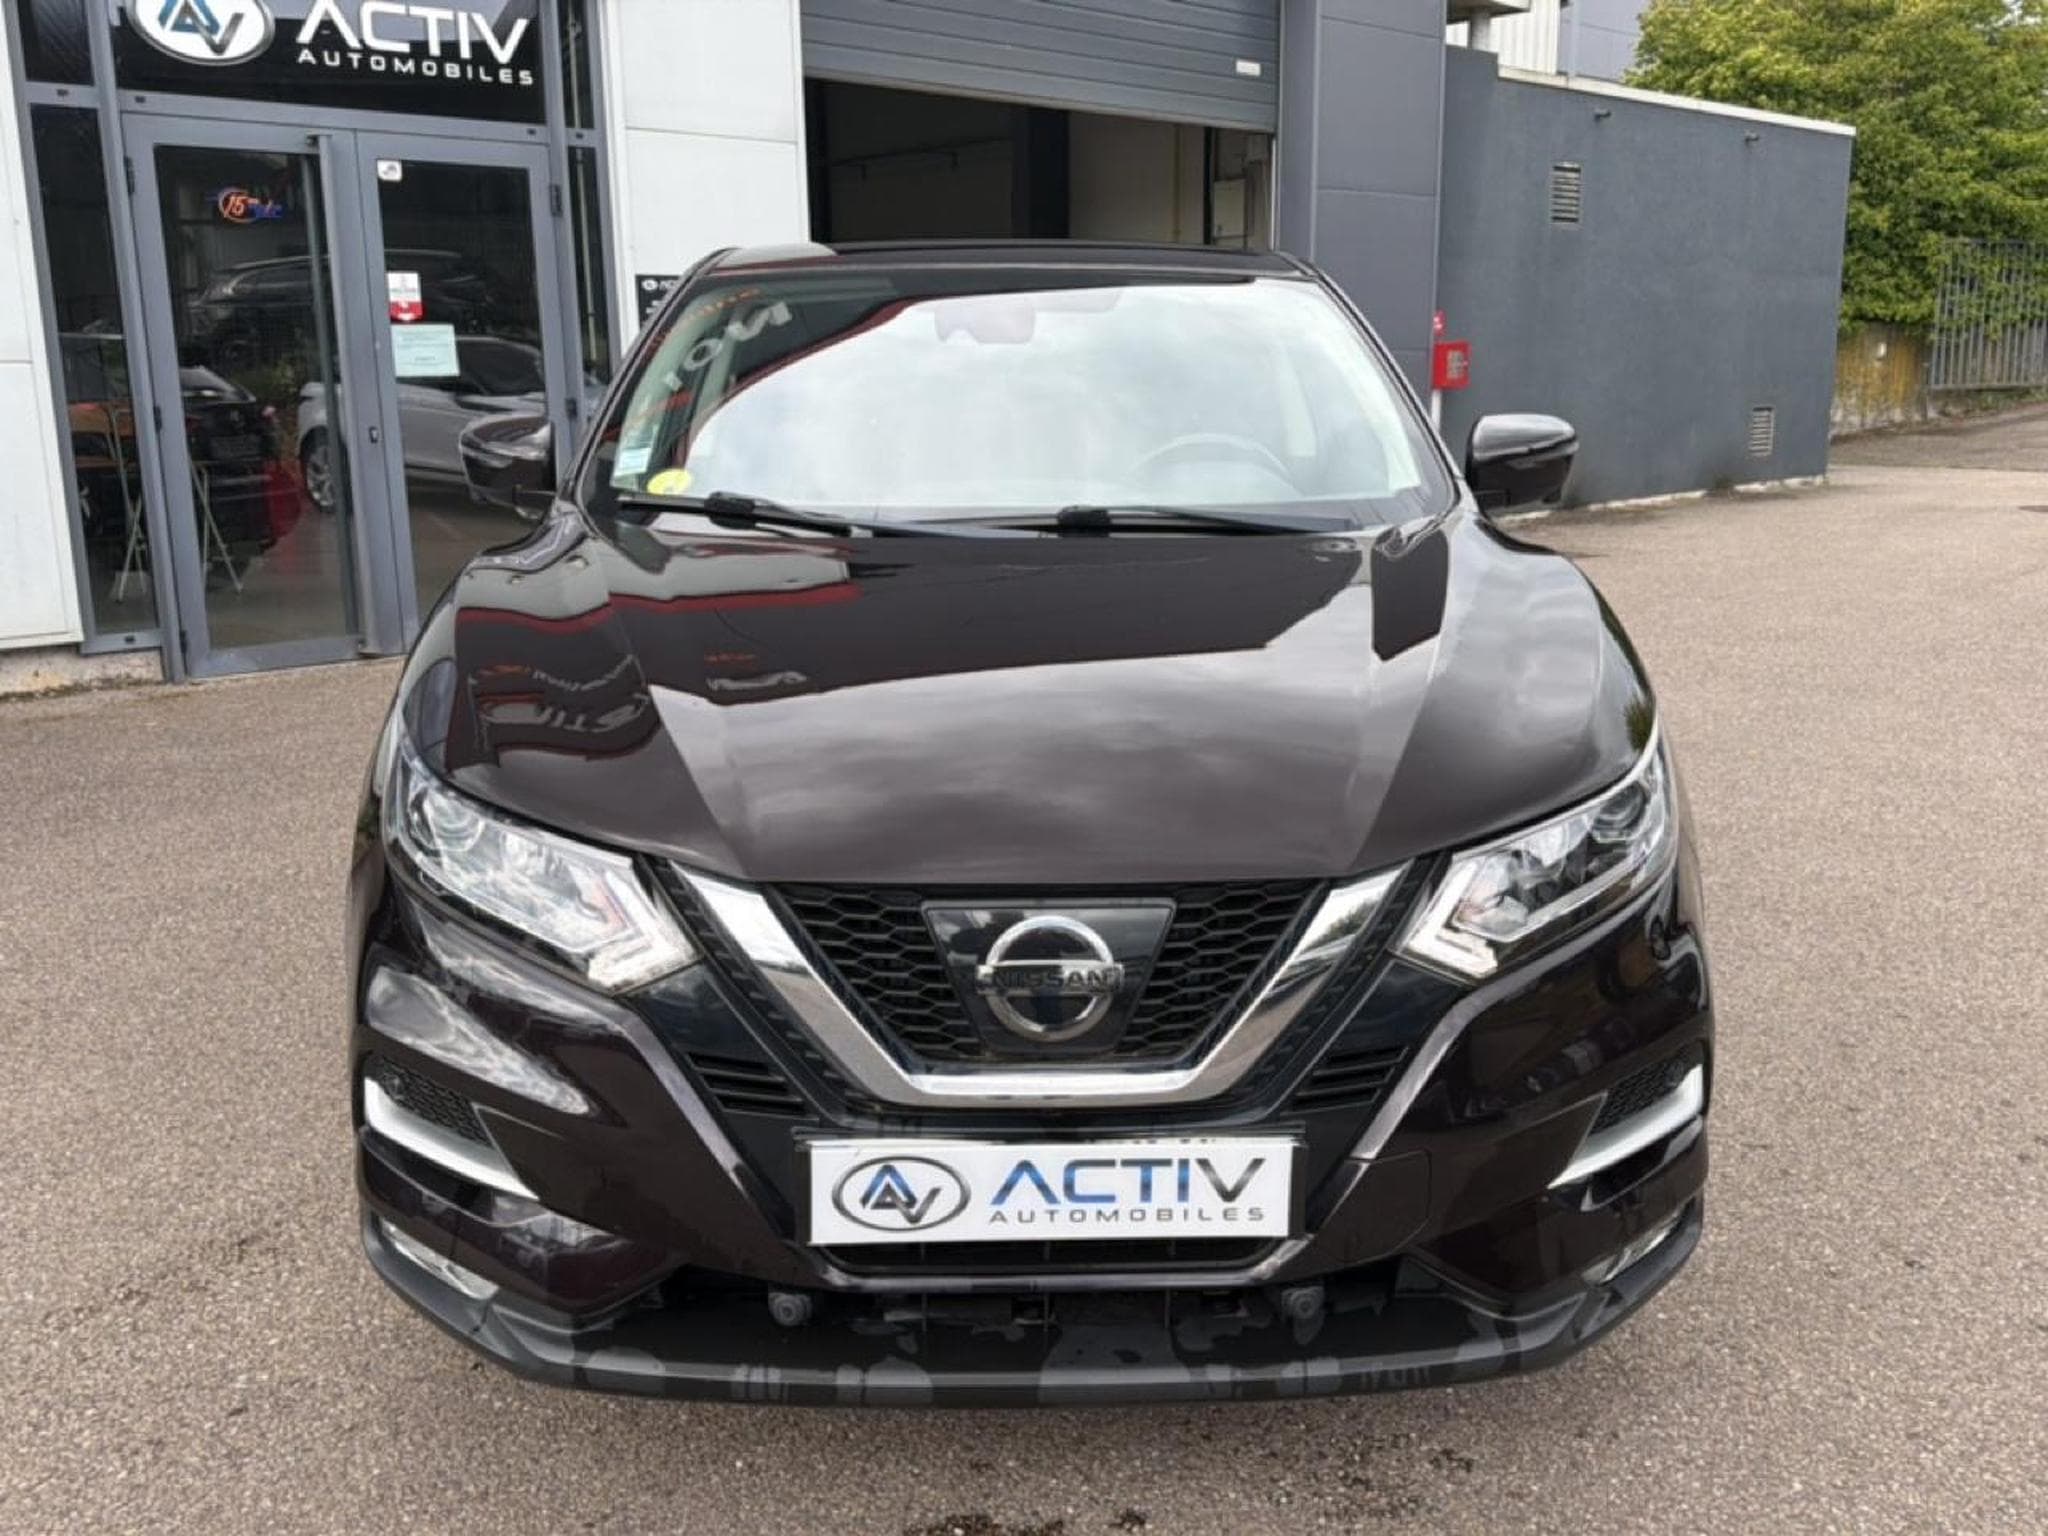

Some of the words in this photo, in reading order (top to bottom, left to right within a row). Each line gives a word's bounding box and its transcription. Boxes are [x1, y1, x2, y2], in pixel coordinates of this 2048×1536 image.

[296, 0, 530, 64] ACTIV
[297, 50, 534, 85] AUTOMOBILES
[993, 969, 1111, 991] NISSAN
[990, 1158, 1266, 1205] ACTIV
[989, 1207, 1265, 1224] AUTOMOBILES
